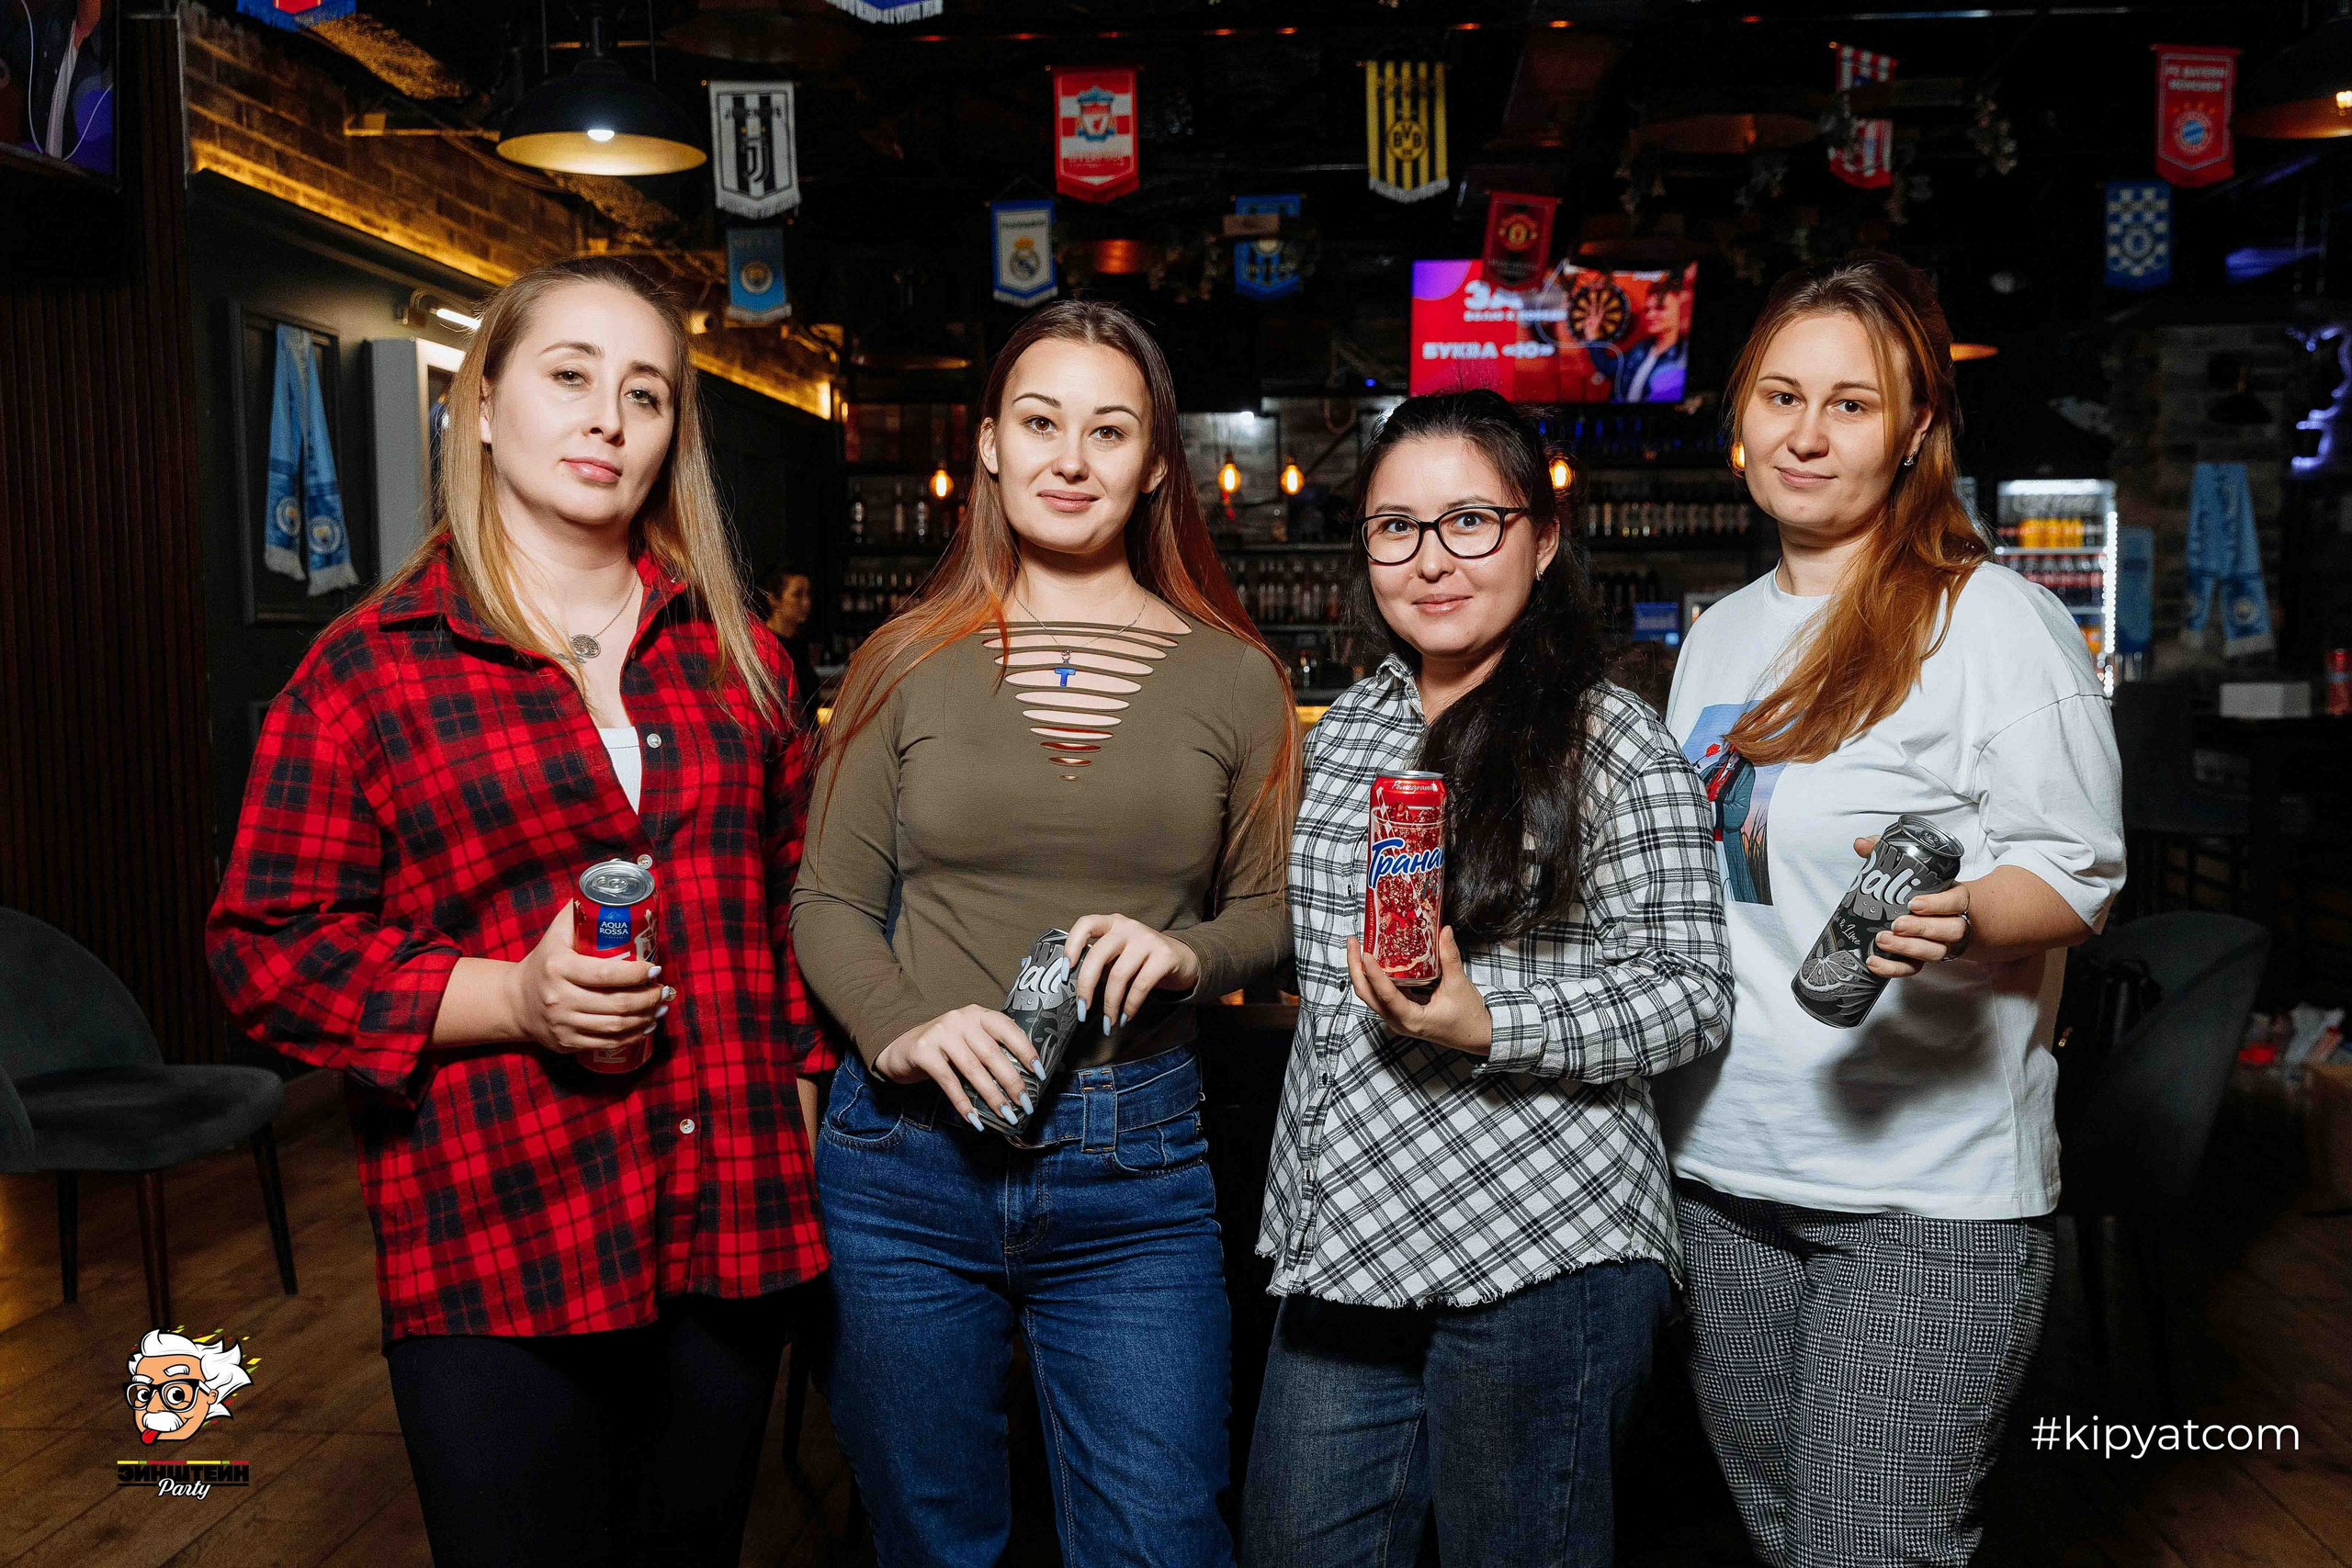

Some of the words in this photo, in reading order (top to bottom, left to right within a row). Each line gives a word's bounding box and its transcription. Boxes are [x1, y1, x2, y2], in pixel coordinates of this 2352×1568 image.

[1422, 341, 1498, 360] БУКВА
[599, 927, 629, 936] ROSSA
[601, 920, 628, 929] AQUA
[1841, 923, 1861, 945] Lime
